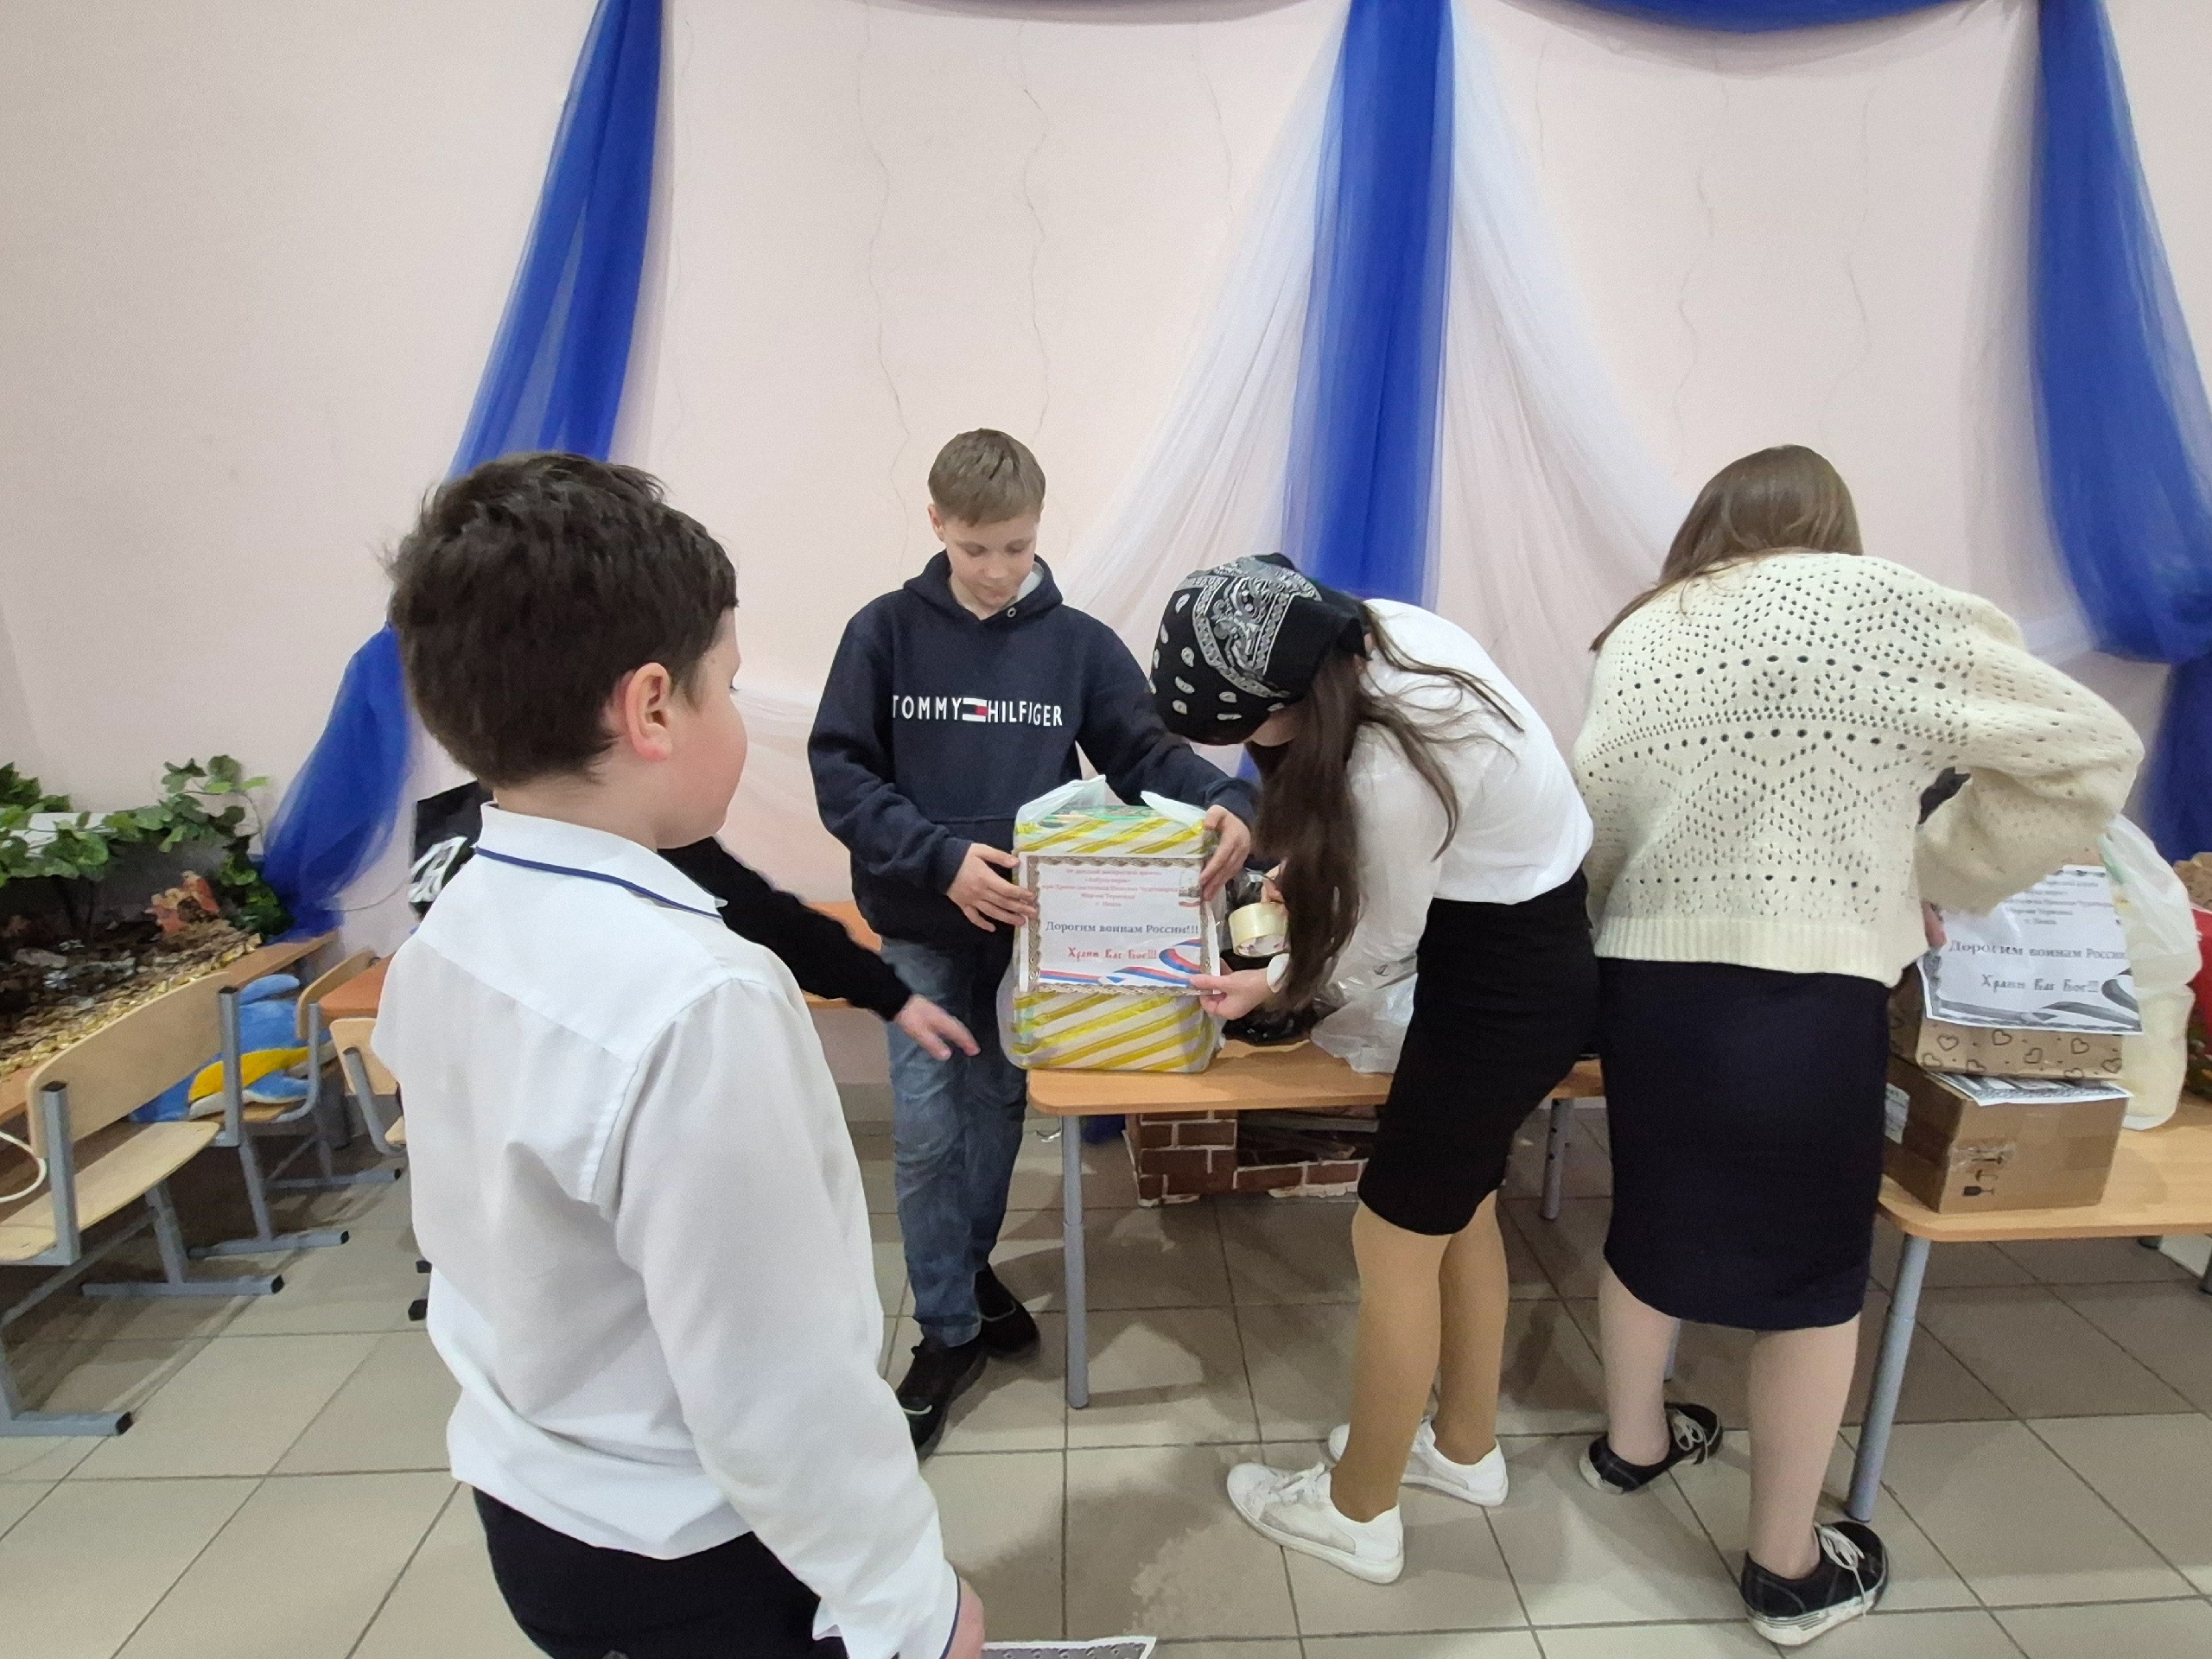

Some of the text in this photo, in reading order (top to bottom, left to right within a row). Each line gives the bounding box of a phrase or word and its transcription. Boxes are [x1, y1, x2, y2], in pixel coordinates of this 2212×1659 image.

[893, 695, 1063, 727] TOMMY HILFIGER
[1046, 921, 1198, 934] Дорогим воинам России!!!
[1948, 940, 2023, 955] Дорогим
[2029, 947, 2082, 958] воинам
